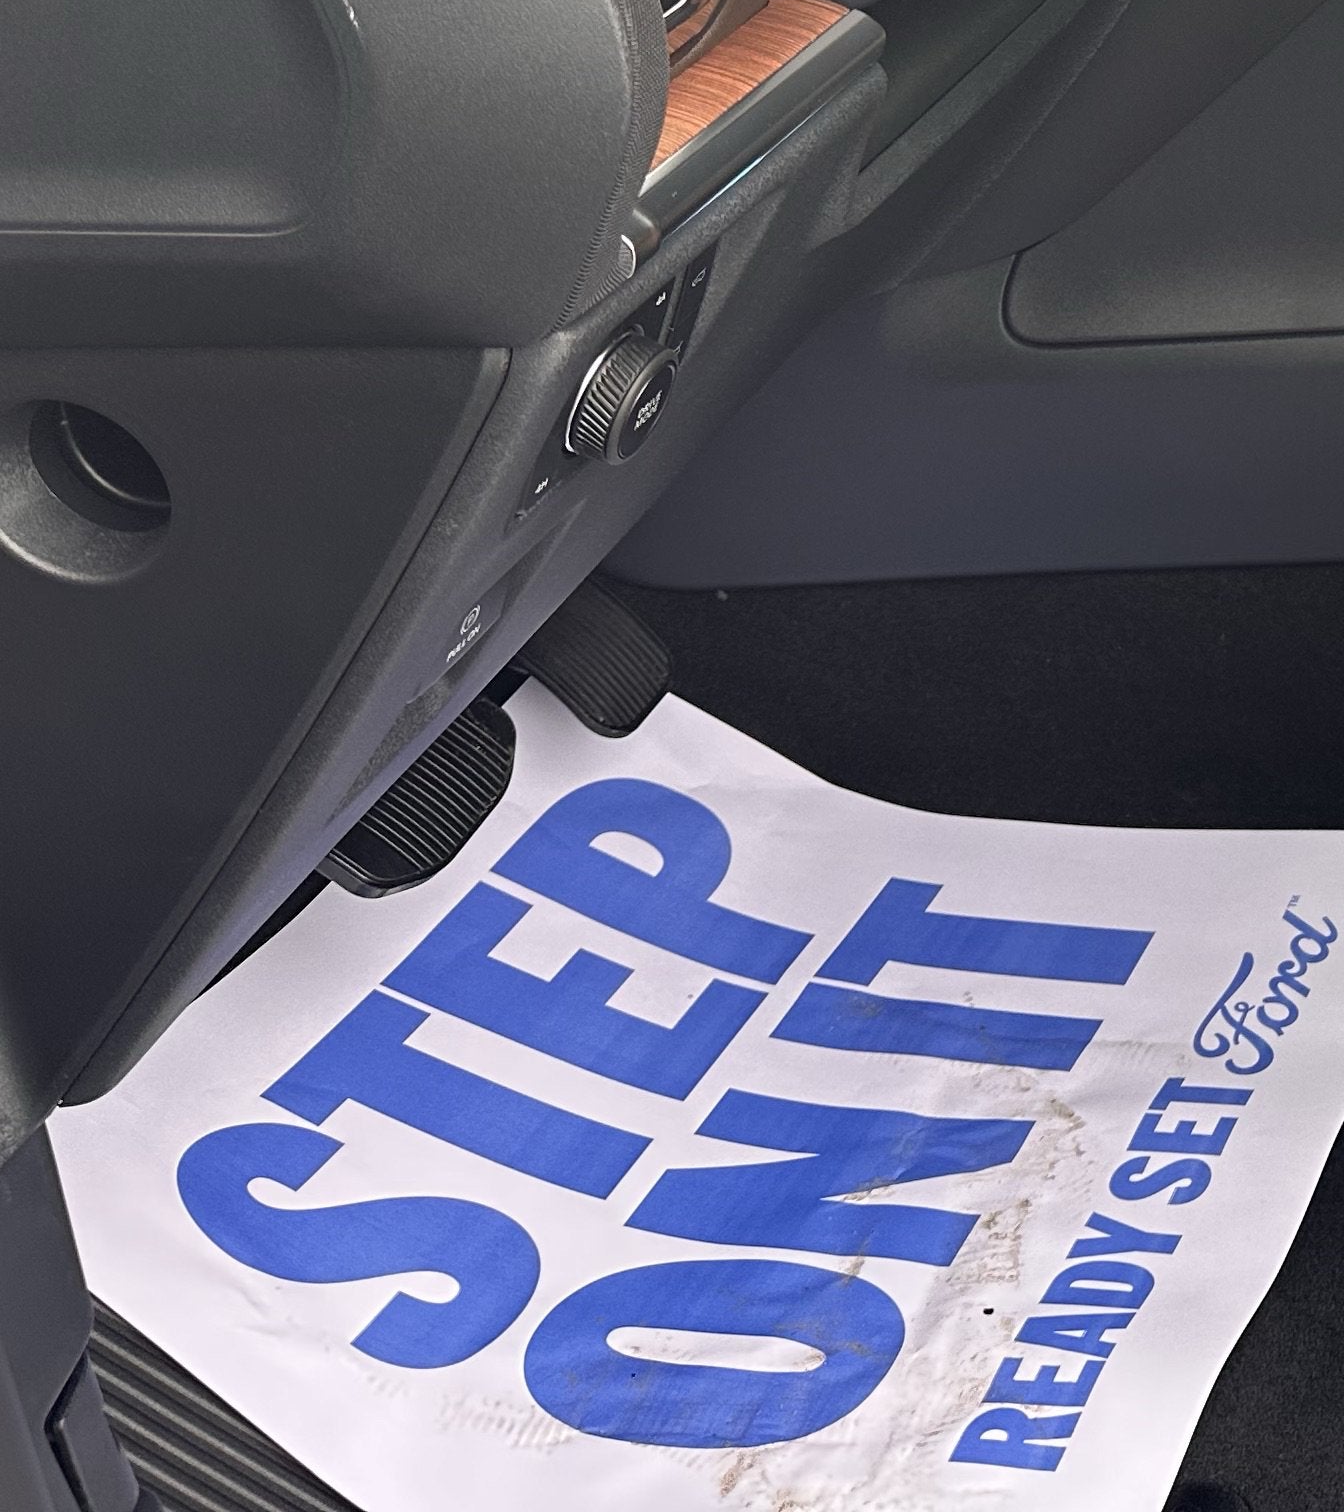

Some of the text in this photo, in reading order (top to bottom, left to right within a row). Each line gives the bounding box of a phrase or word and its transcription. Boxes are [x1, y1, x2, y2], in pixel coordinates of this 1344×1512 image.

[633, 400, 659, 431] MODE
[637, 390, 663, 419] DRIVE
[176, 778, 813, 1369] STEP
[523, 877, 1153, 1449] ON IT
[949, 1212, 1181, 1471] READY
[1109, 1076, 1252, 1205] SET
[1192, 909, 1339, 1075] Ford
